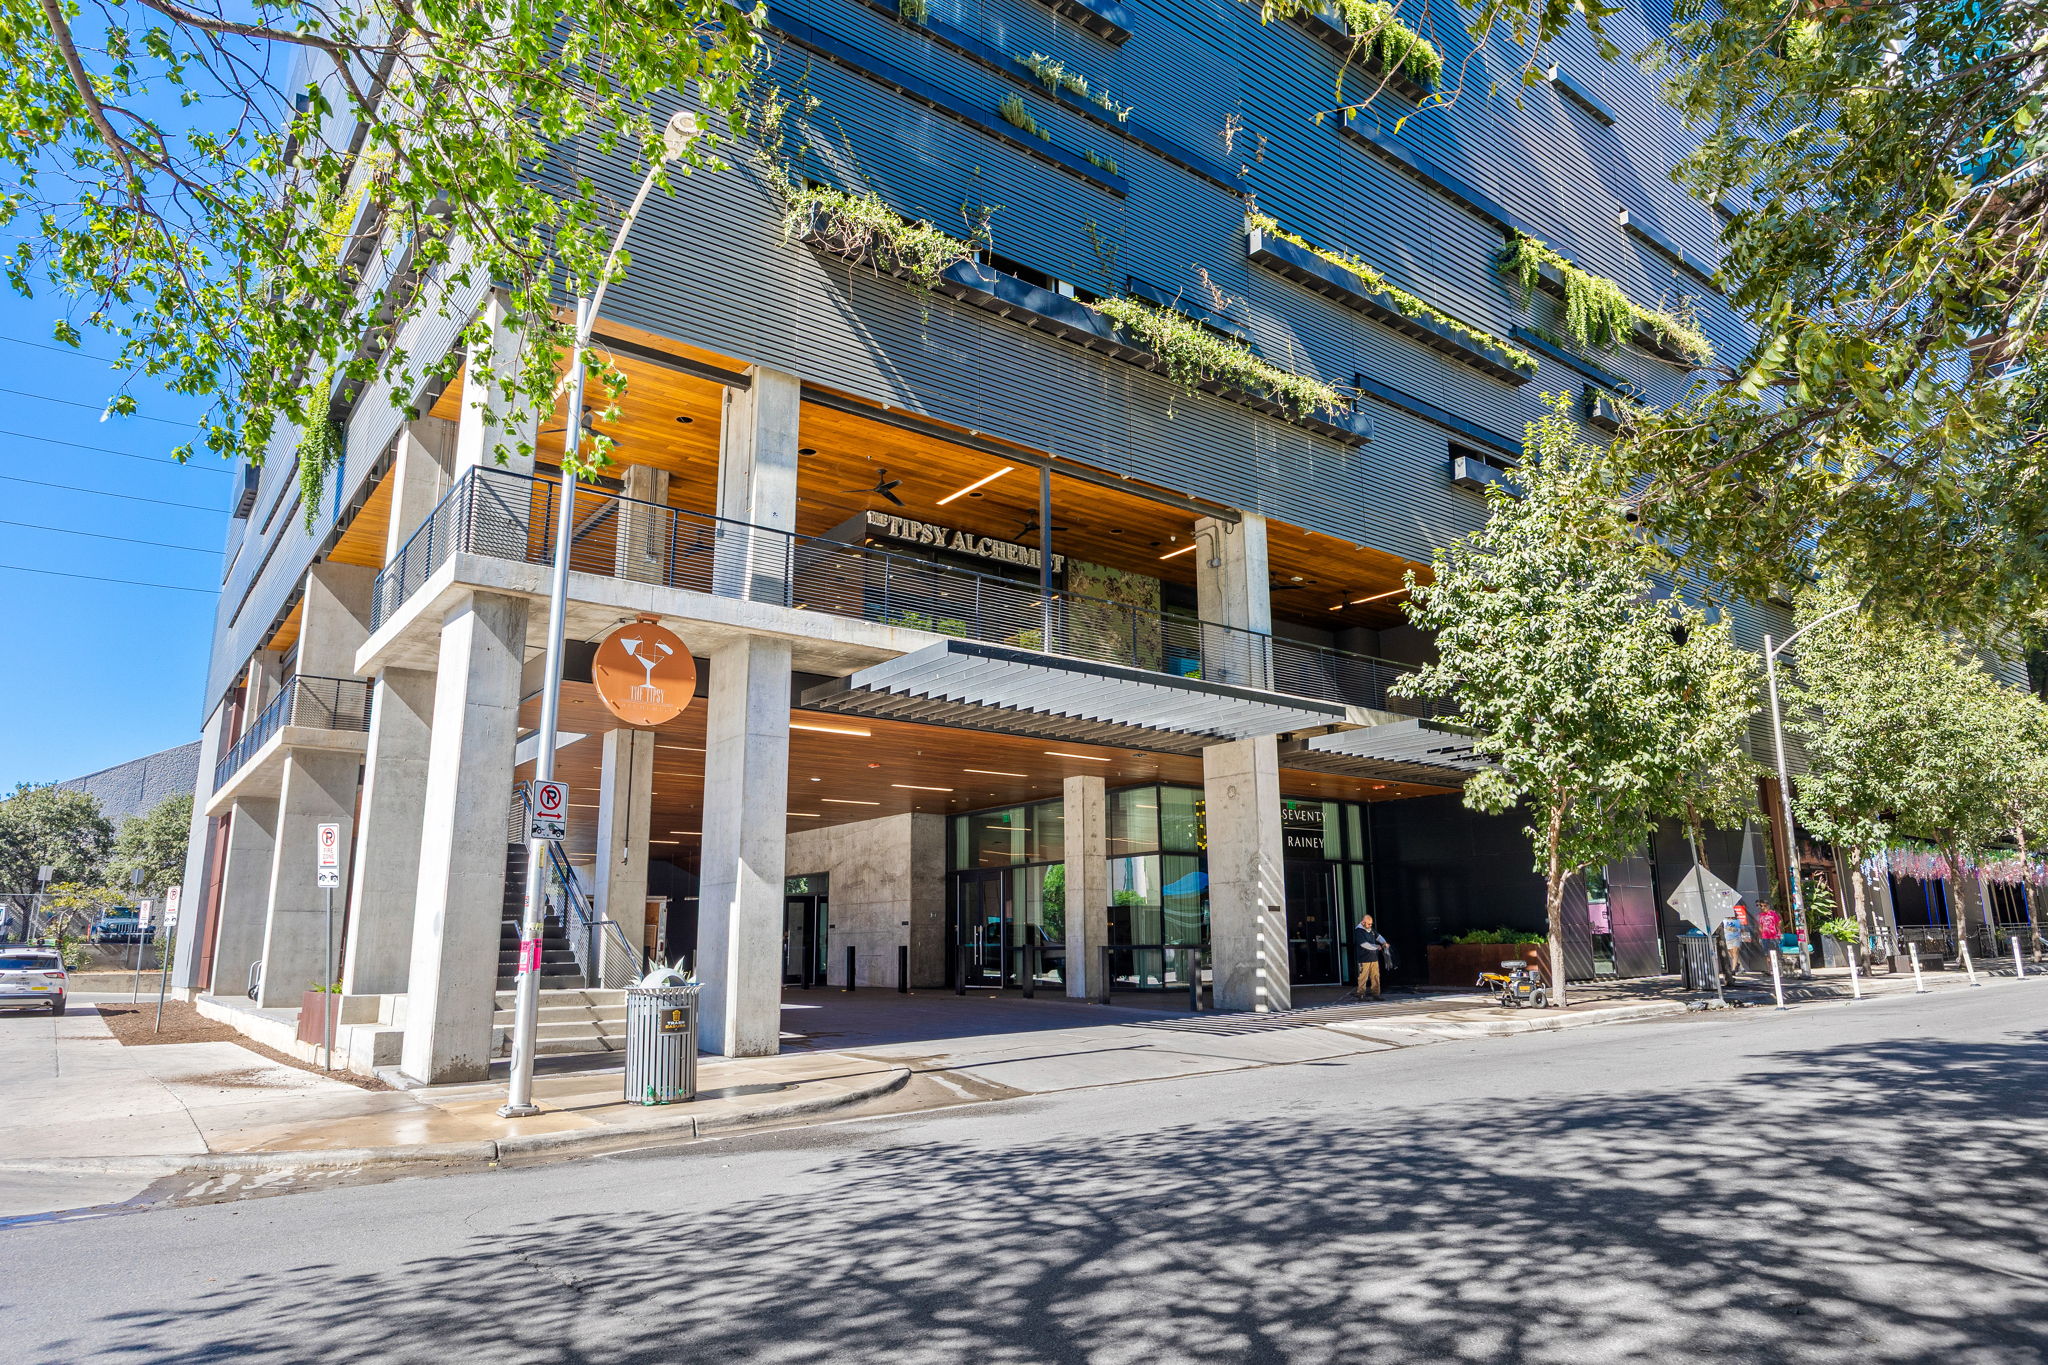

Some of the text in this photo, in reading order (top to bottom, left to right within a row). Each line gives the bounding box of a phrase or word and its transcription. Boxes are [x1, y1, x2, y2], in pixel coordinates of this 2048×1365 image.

[866, 510, 1065, 574] THE TIPSY ALCHEMIT
[1282, 809, 1328, 822] SEVENTY
[1288, 836, 1325, 849] RAINEY
